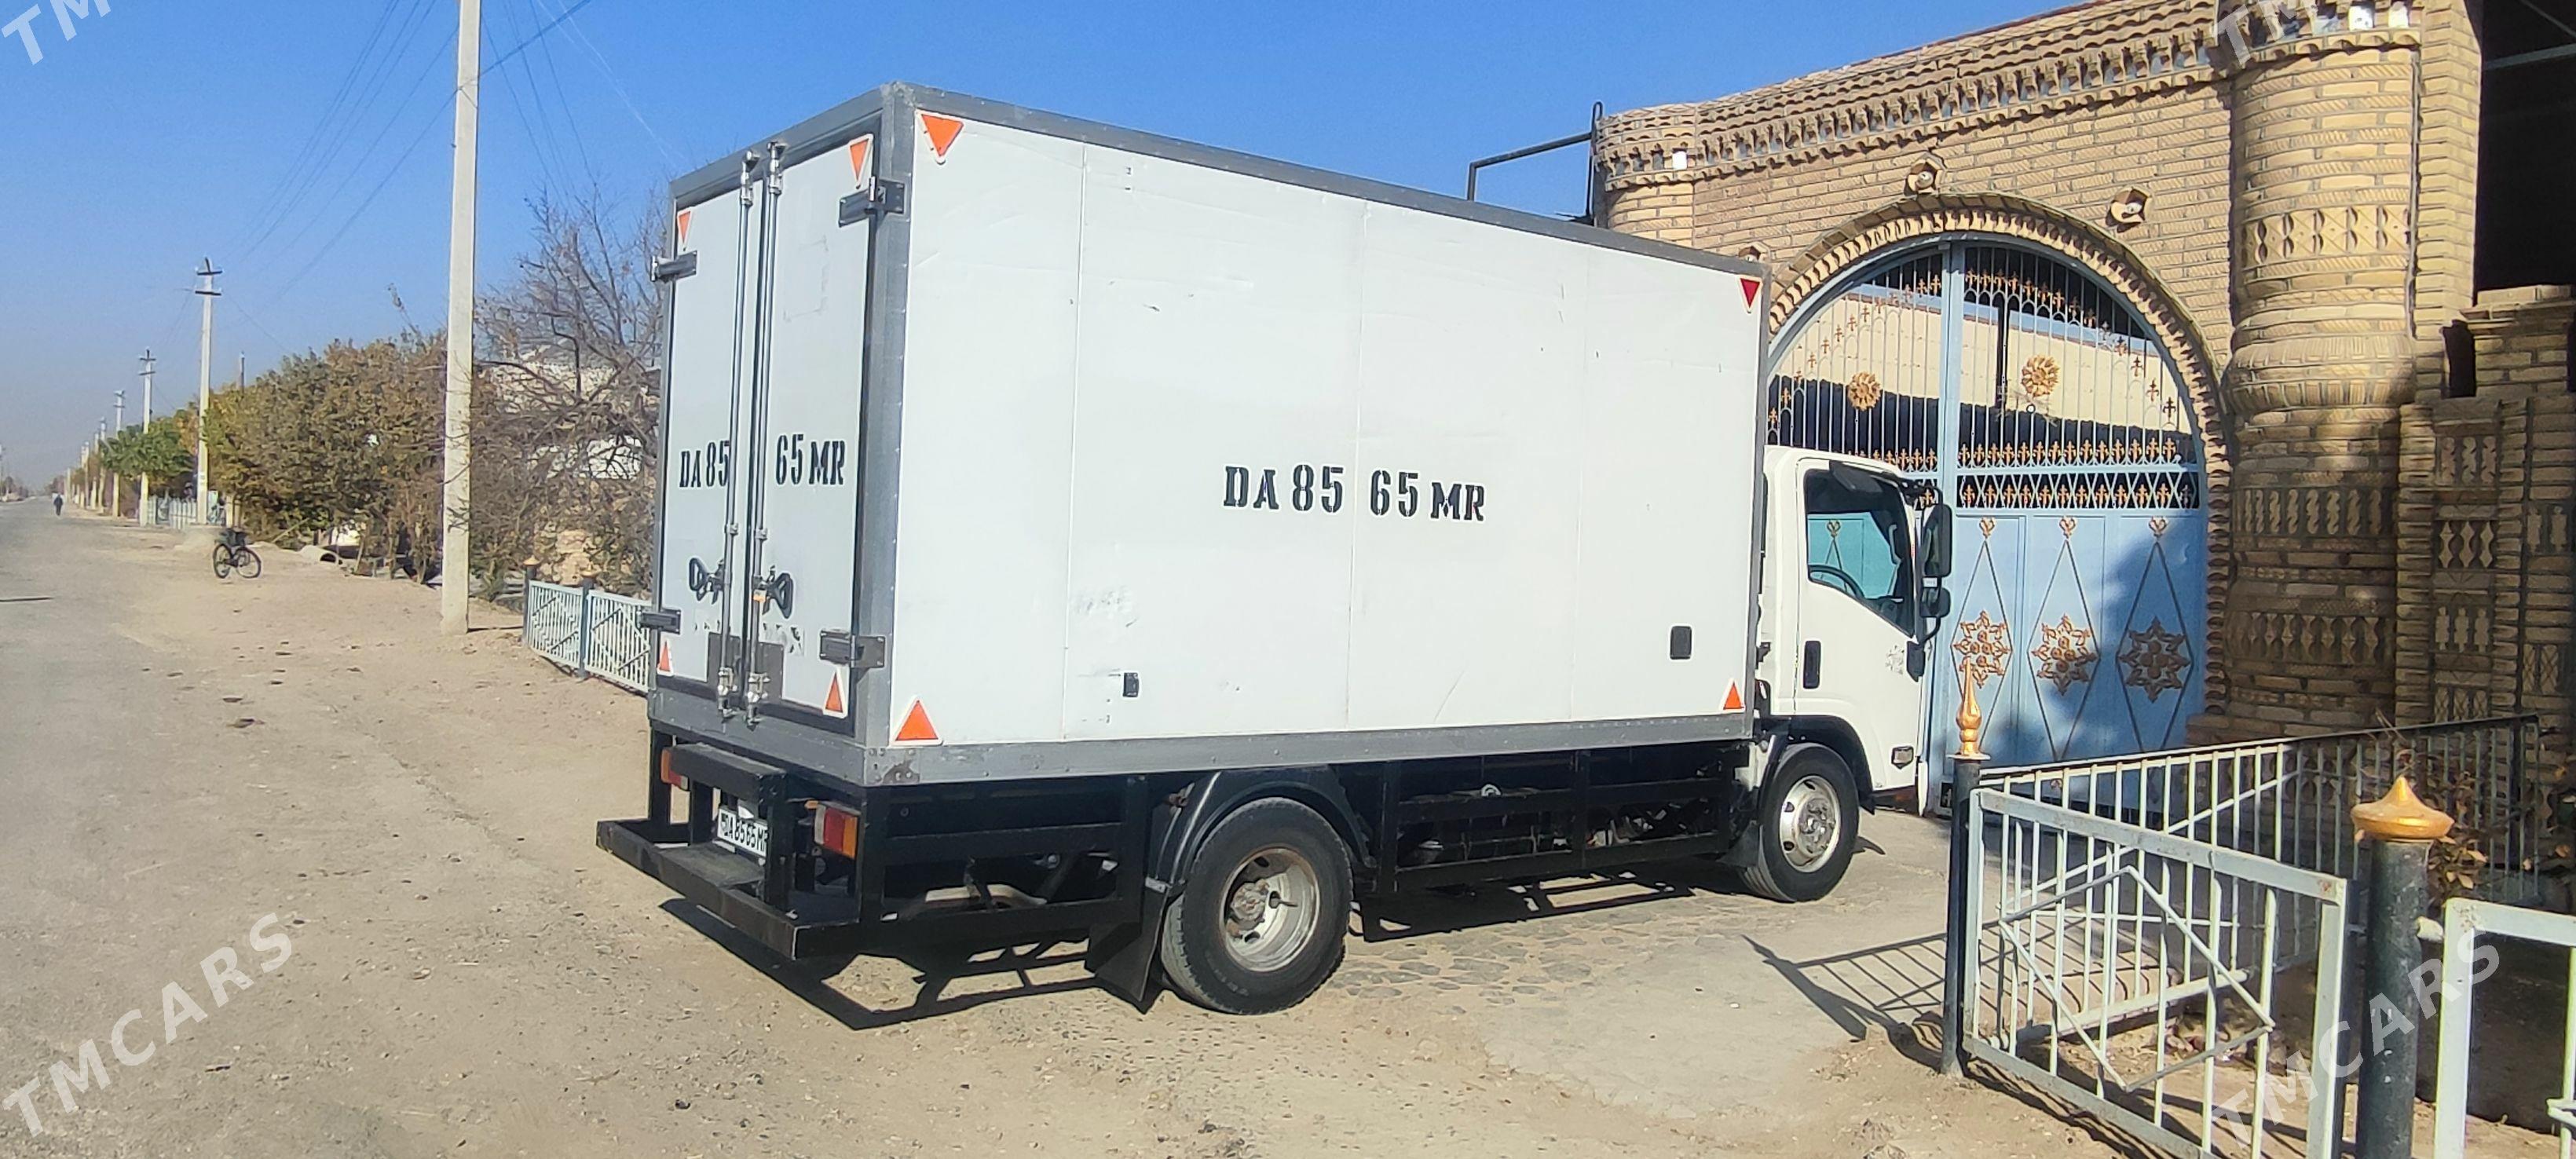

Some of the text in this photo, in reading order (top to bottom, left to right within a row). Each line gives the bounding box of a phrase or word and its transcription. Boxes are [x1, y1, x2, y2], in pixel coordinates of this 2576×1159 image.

[679, 433, 846, 488] DA 85 65 MR
[1224, 464, 1485, 521] DA 85 65 MR
